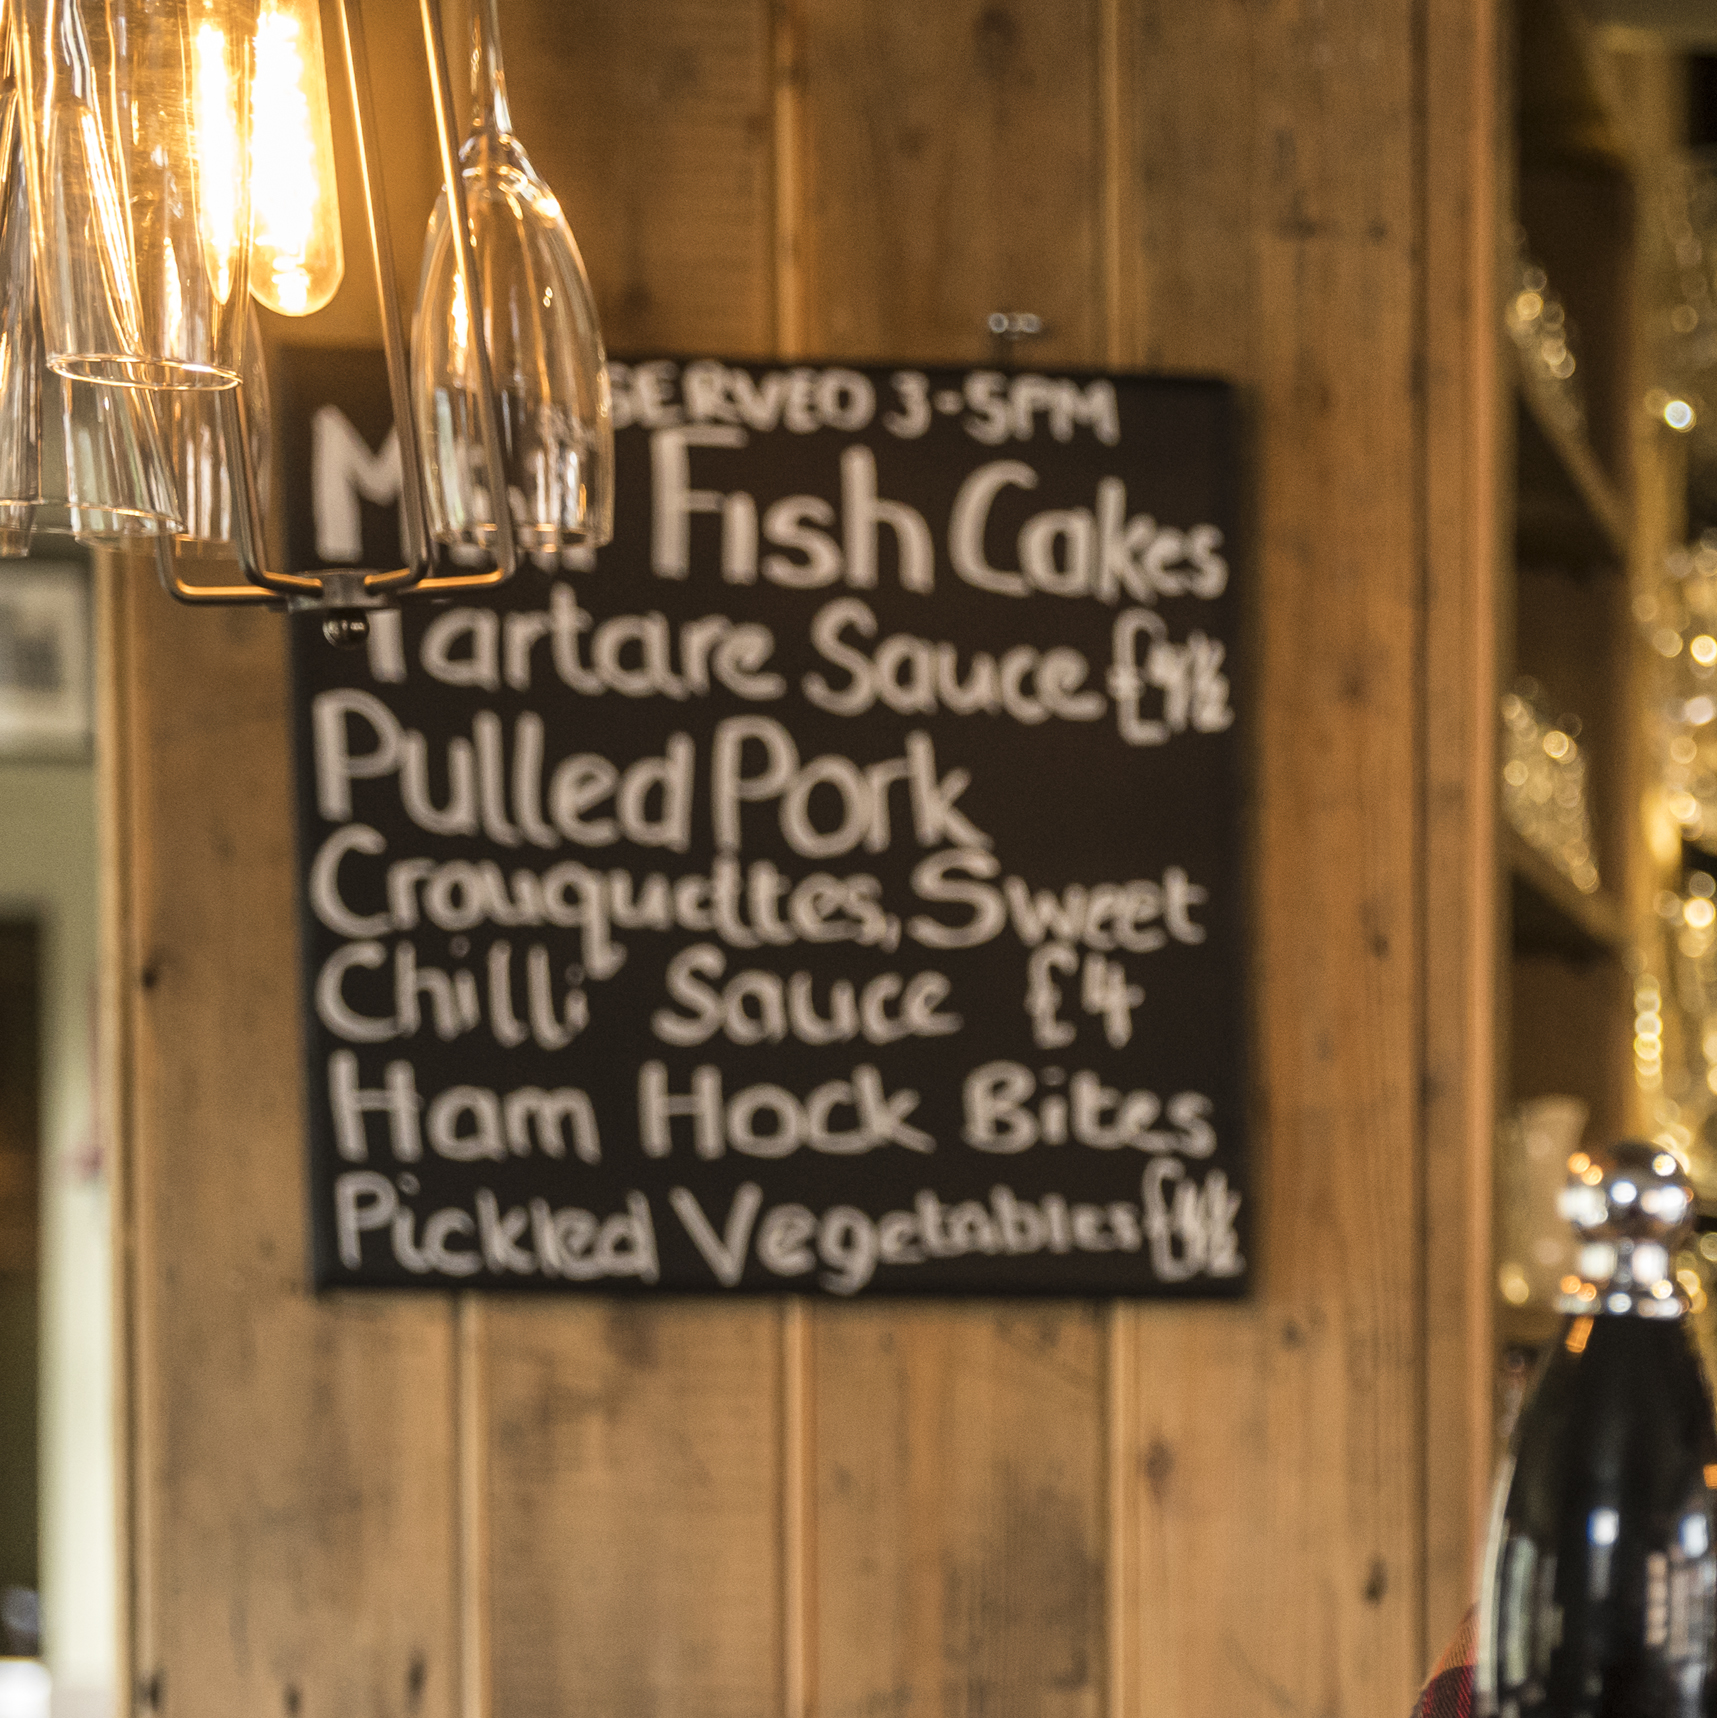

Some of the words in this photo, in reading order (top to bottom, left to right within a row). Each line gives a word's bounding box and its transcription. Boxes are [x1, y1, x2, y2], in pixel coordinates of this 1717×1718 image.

[650, 424, 938, 596] Fish
[946, 458, 1229, 604] Cakes
[801, 598, 1108, 722] Sauce
[310, 687, 696, 853] Pulled
[709, 714, 996, 860] Pork
[908, 846, 1208, 952] Sweet
[314, 938, 592, 1050] Chilli
[650, 940, 964, 1047] Sauce
[1022, 945, 1147, 1050] £4
[328, 1048, 602, 1165] Ham
[638, 1058, 938, 1160] Hock
[960, 1060, 1216, 1157] Bites
[332, 1170, 660, 1283] Pickled
[669, 1182, 1145, 1296] Vegetables
